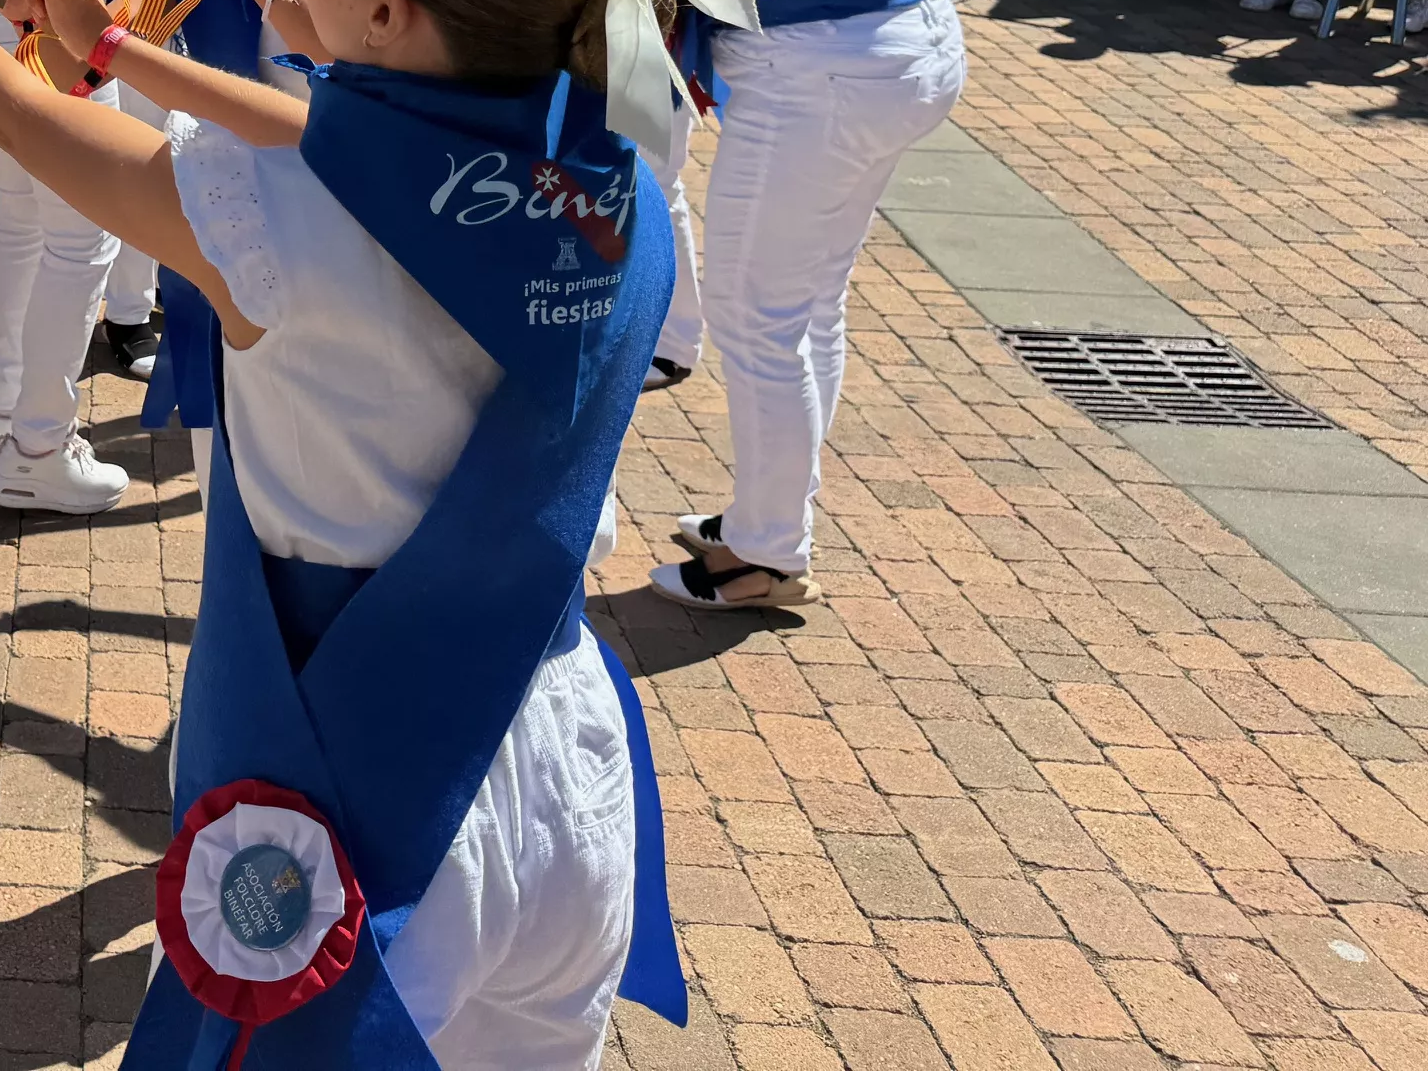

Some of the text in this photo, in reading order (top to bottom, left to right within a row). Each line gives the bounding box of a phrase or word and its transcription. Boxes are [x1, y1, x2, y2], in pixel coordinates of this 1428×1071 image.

[429, 150, 638, 237] Binéf
[524, 272, 622, 297] ¡Mis primeras
[224, 889, 253, 940] BINÉFAR
[233, 876, 269, 935] FOLCLORE
[241, 862, 284, 933] ASOCIACIÓN
